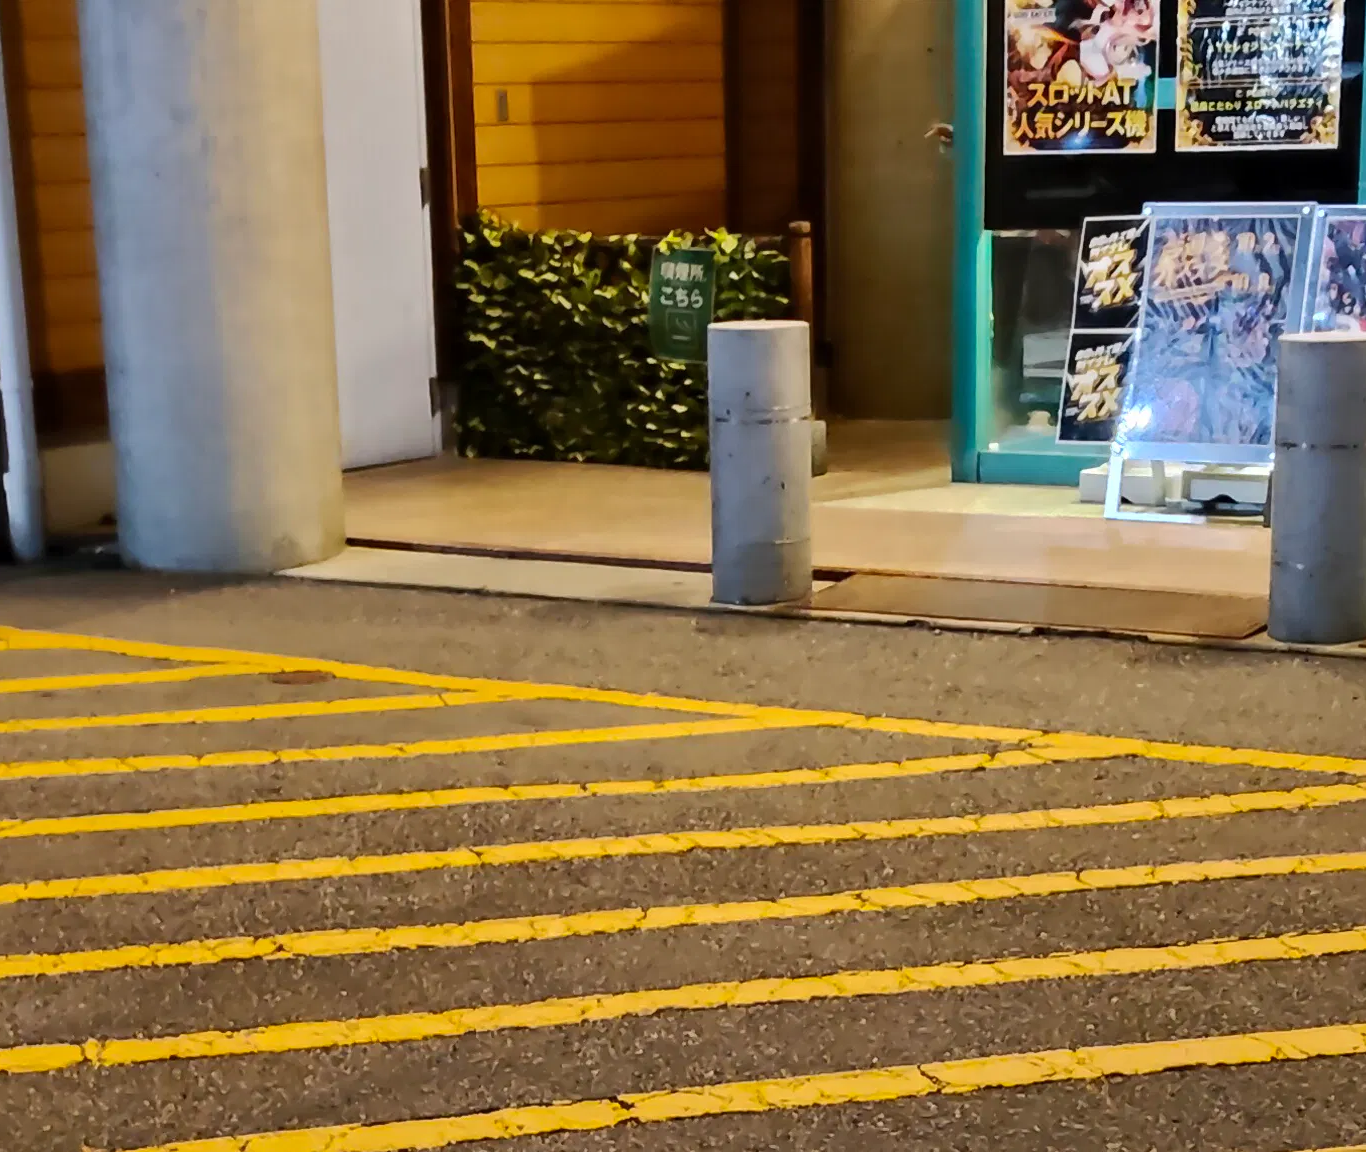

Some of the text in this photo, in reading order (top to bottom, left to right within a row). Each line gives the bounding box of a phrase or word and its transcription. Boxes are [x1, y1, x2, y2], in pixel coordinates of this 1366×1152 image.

[1027, 80, 1136, 107] スロットAT
[1015, 110, 1147, 139] 人気シリーズ機
[660, 286, 703, 309] こちら
